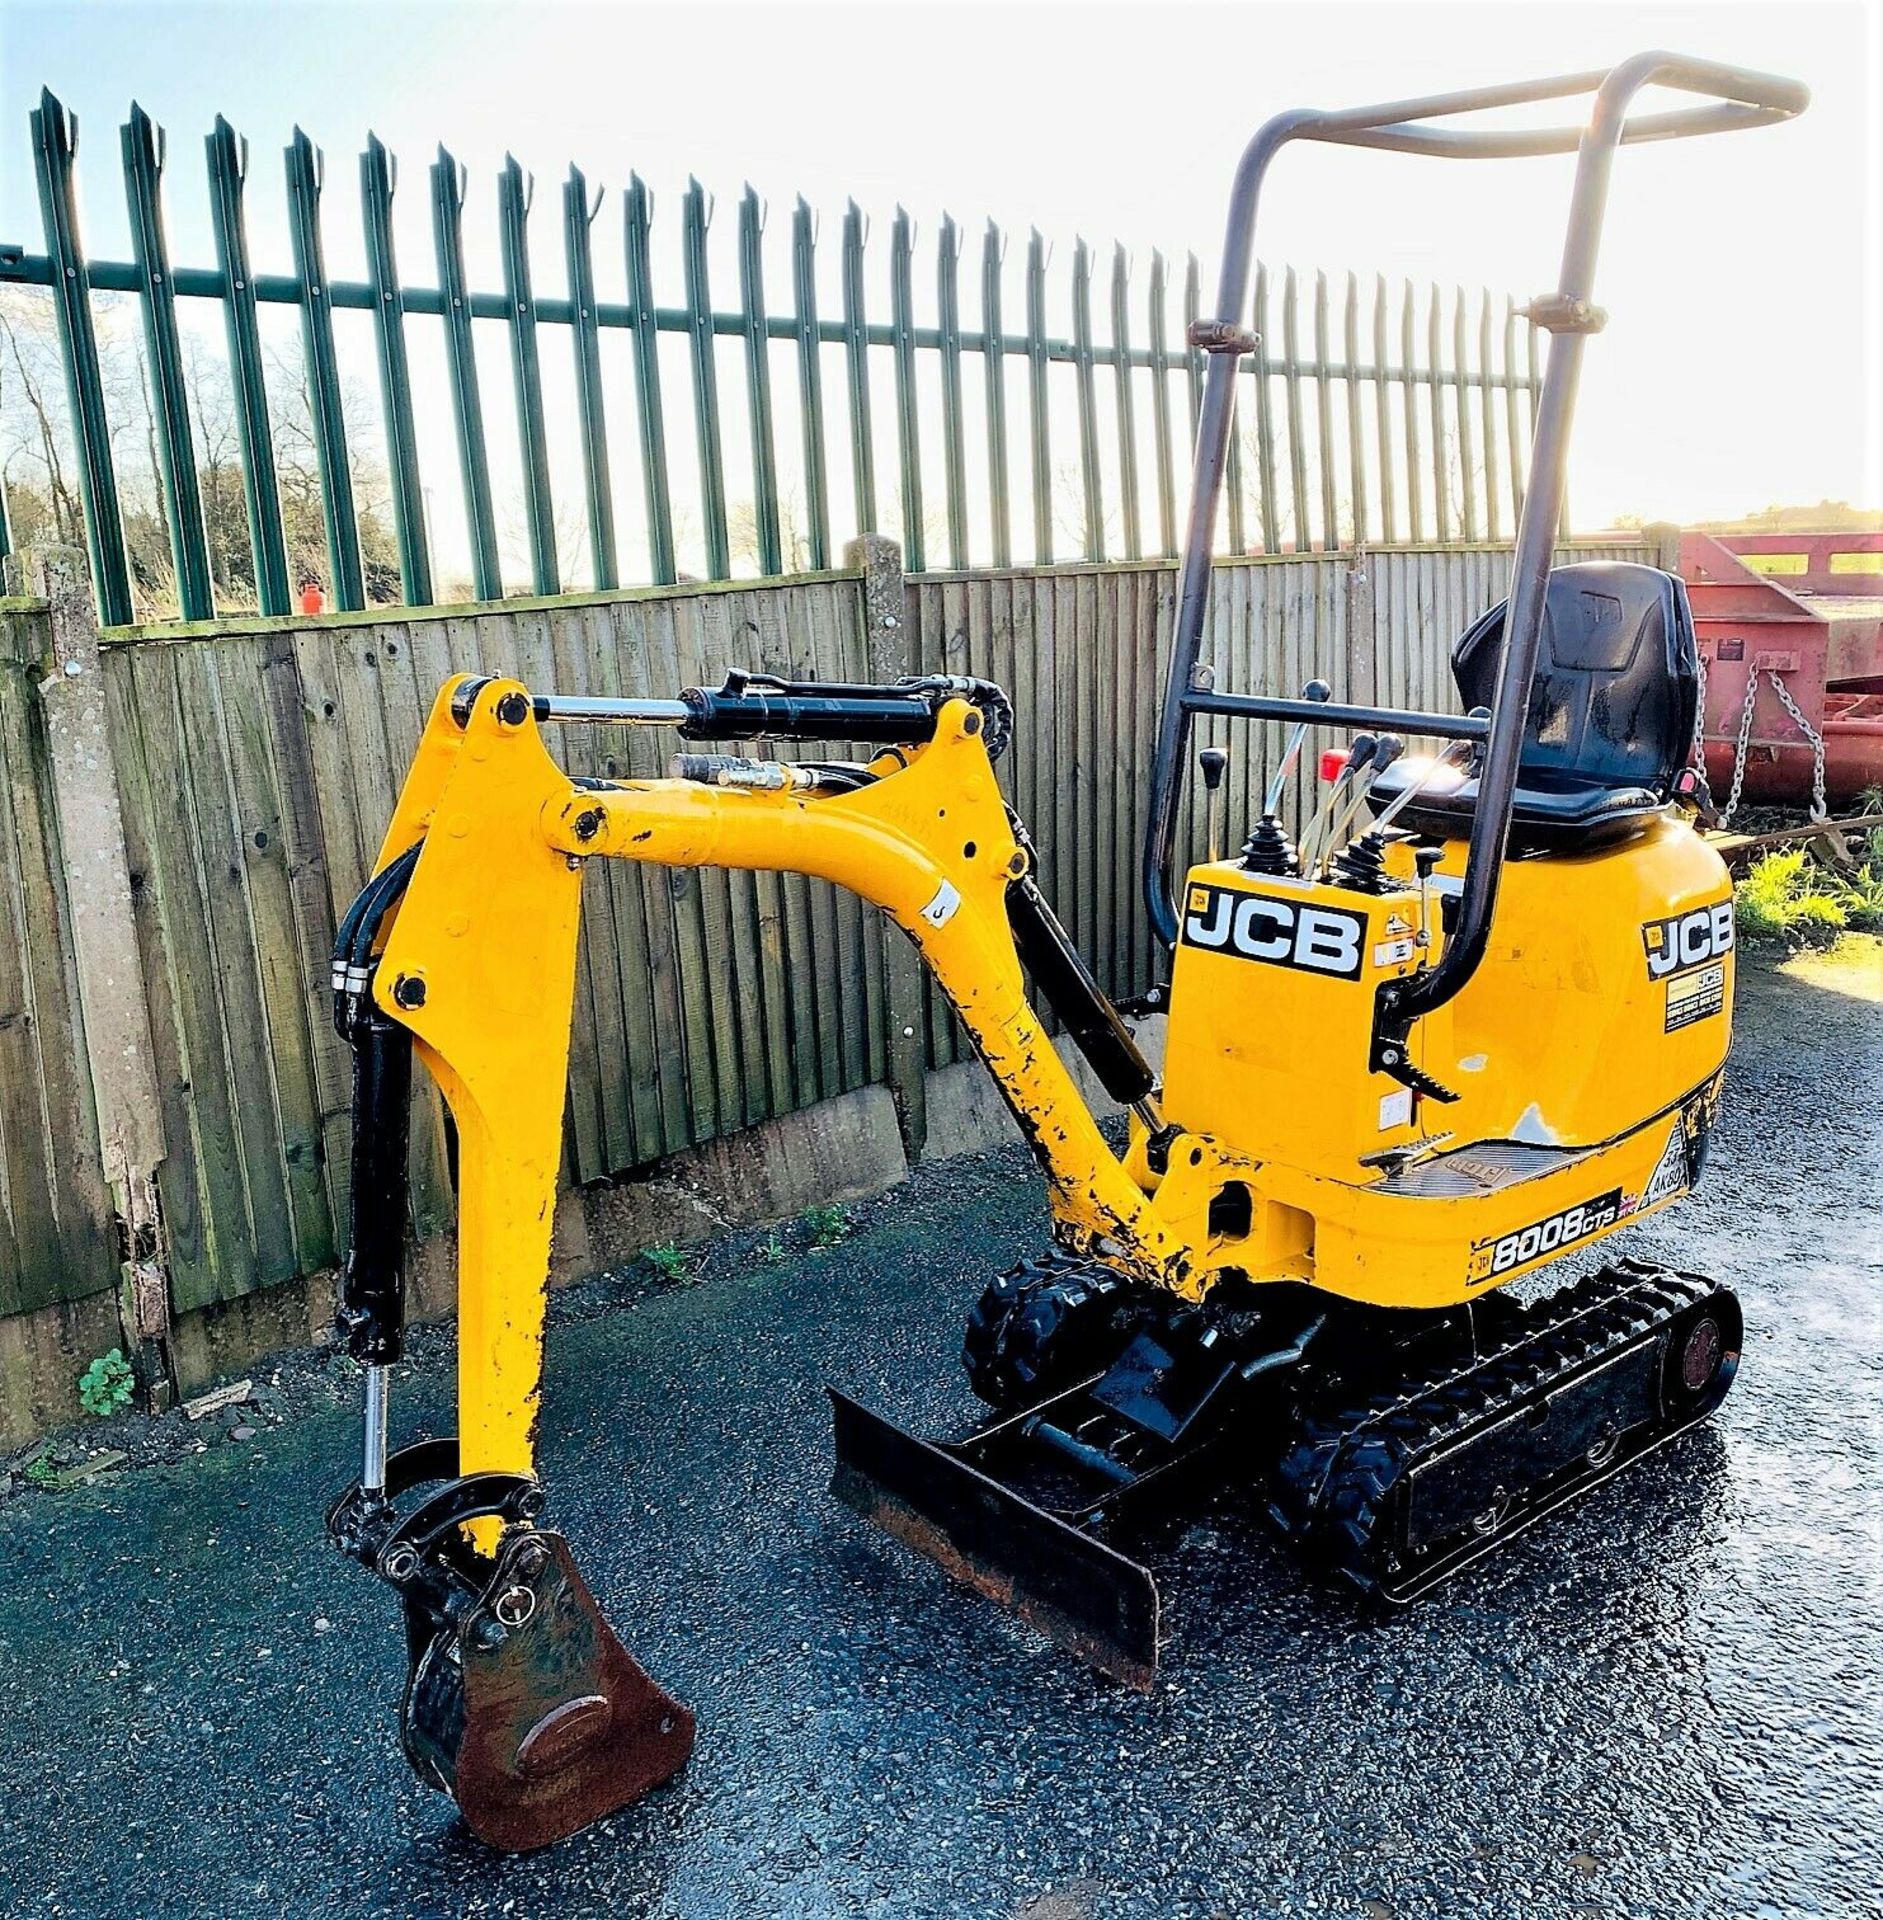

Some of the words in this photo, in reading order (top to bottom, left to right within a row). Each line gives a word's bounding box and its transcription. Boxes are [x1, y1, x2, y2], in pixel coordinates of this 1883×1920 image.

[1187, 893, 1361, 973] JCB
[1650, 903, 1733, 974] JCB
[1698, 968, 1722, 989] JCB
